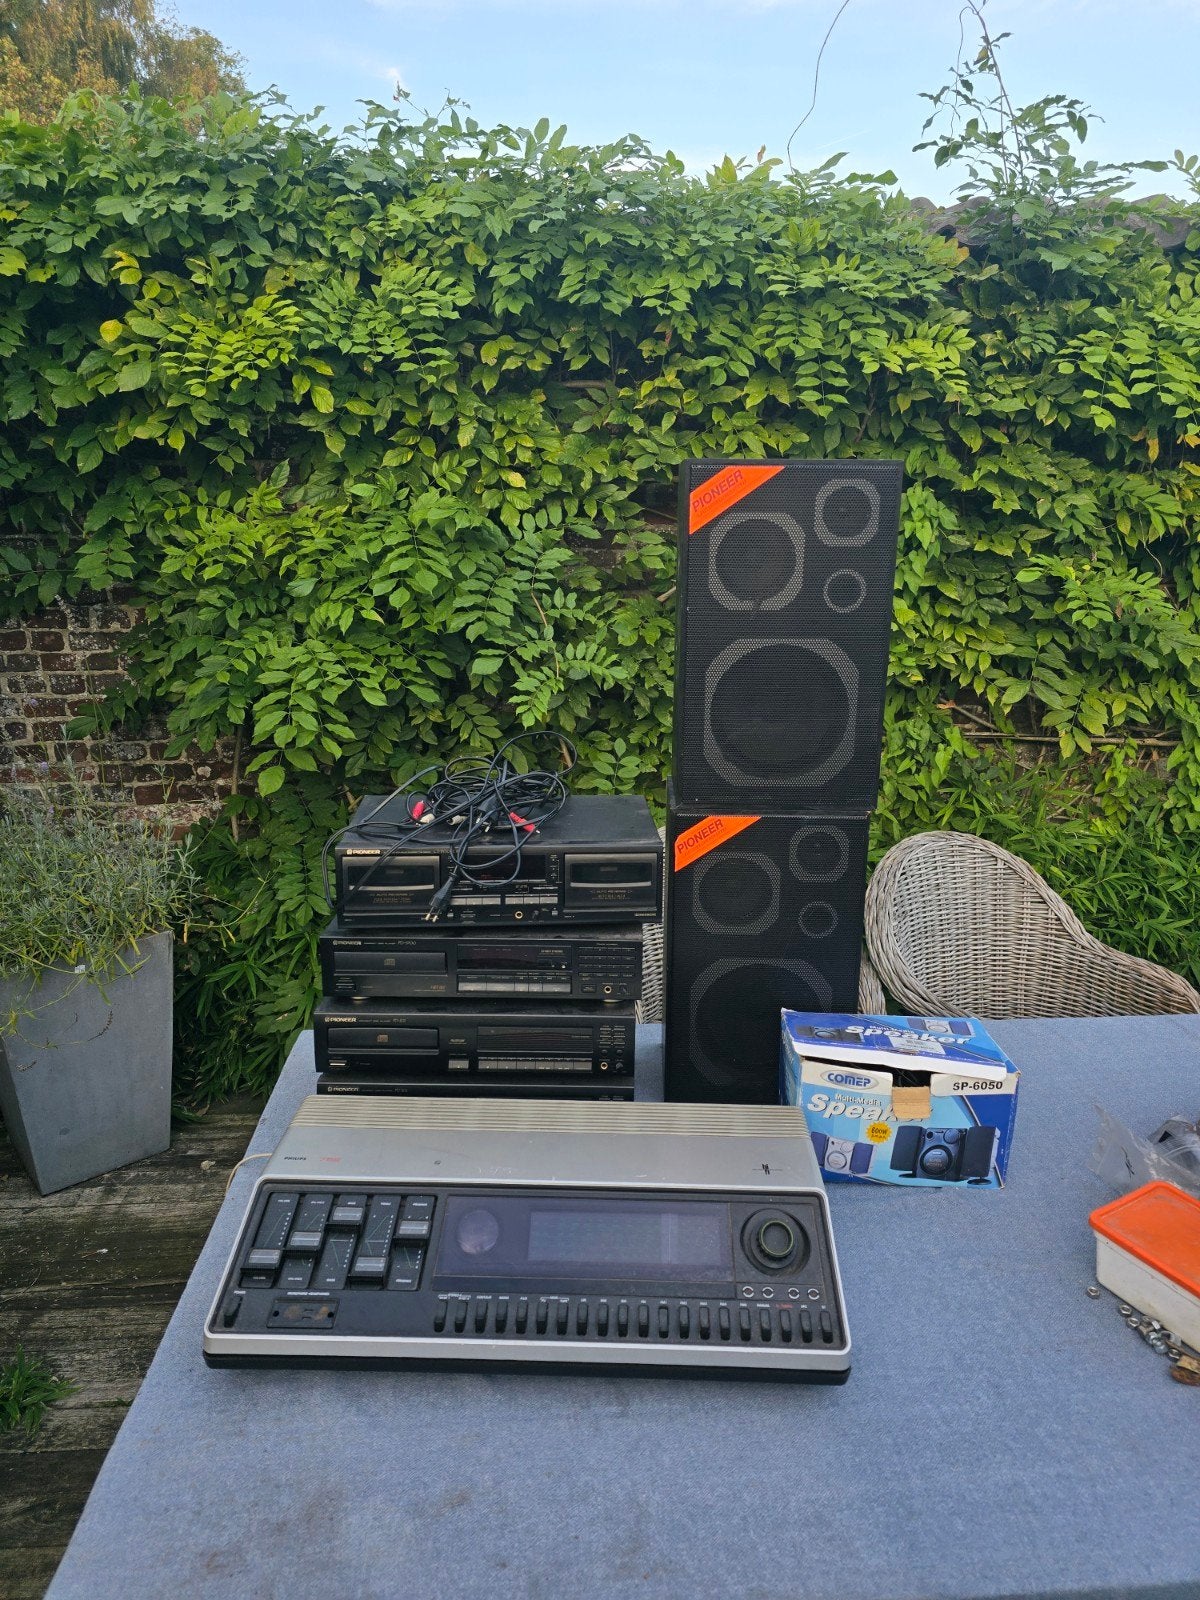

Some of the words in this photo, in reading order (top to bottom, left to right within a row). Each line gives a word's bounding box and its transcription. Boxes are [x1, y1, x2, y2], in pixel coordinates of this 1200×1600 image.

[692, 469, 744, 513] PIONEER
[676, 818, 724, 855] PIONEER
[845, 1025, 971, 1045] Speaker
[827, 1071, 872, 1088] COMEP
[952, 1081, 1004, 1091] SP-6050
[807, 1093, 933, 1122] Speak
